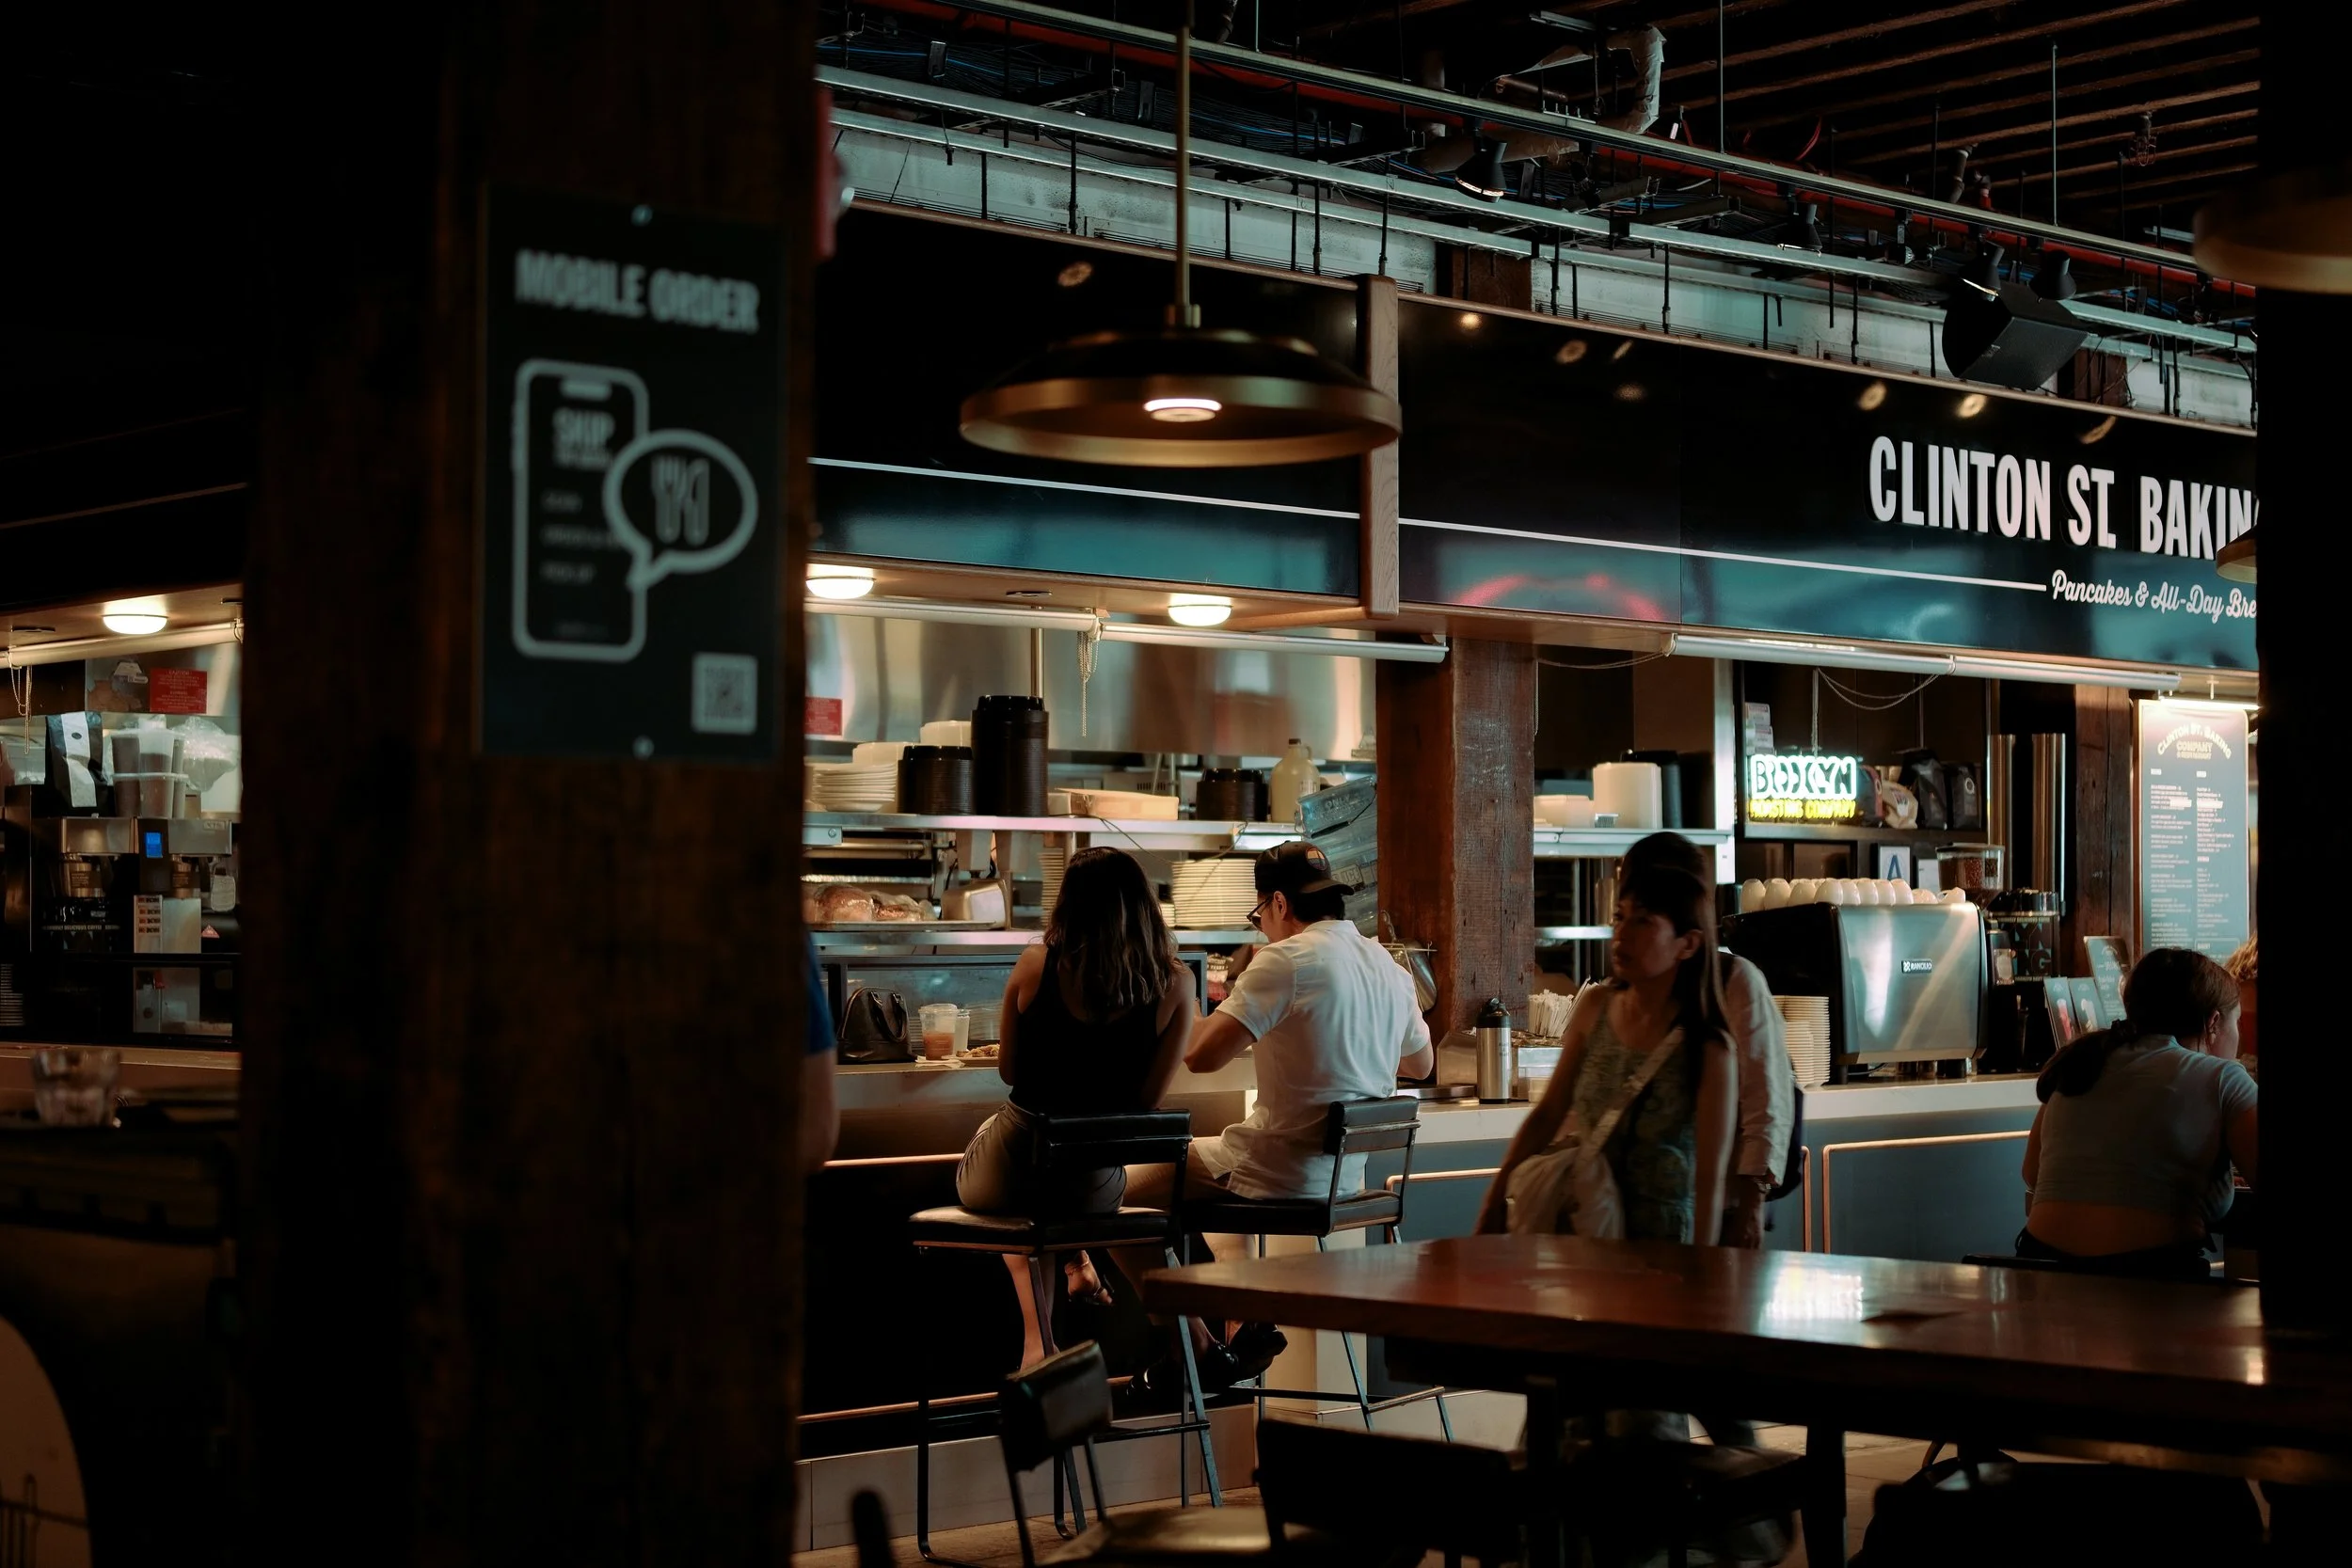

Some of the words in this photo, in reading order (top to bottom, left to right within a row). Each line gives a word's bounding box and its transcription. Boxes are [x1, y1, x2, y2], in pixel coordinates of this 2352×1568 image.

[515, 247, 645, 318] MOBILE
[648, 267, 760, 335] ORDER
[1869, 436, 2050, 541] CLINTON
[2067, 464, 2117, 549] ST.
[2139, 475, 2260, 561] BAKIN
[2052, 569, 2134, 607] Pancakes
[2135, 580, 2150, 609] &
[2151, 580, 2224, 625] All-Day
[2176, 740, 2214, 753] COMPANY
[1751, 754, 1857, 800] BROOKLYN
[1887, 854, 1902, 881] A
